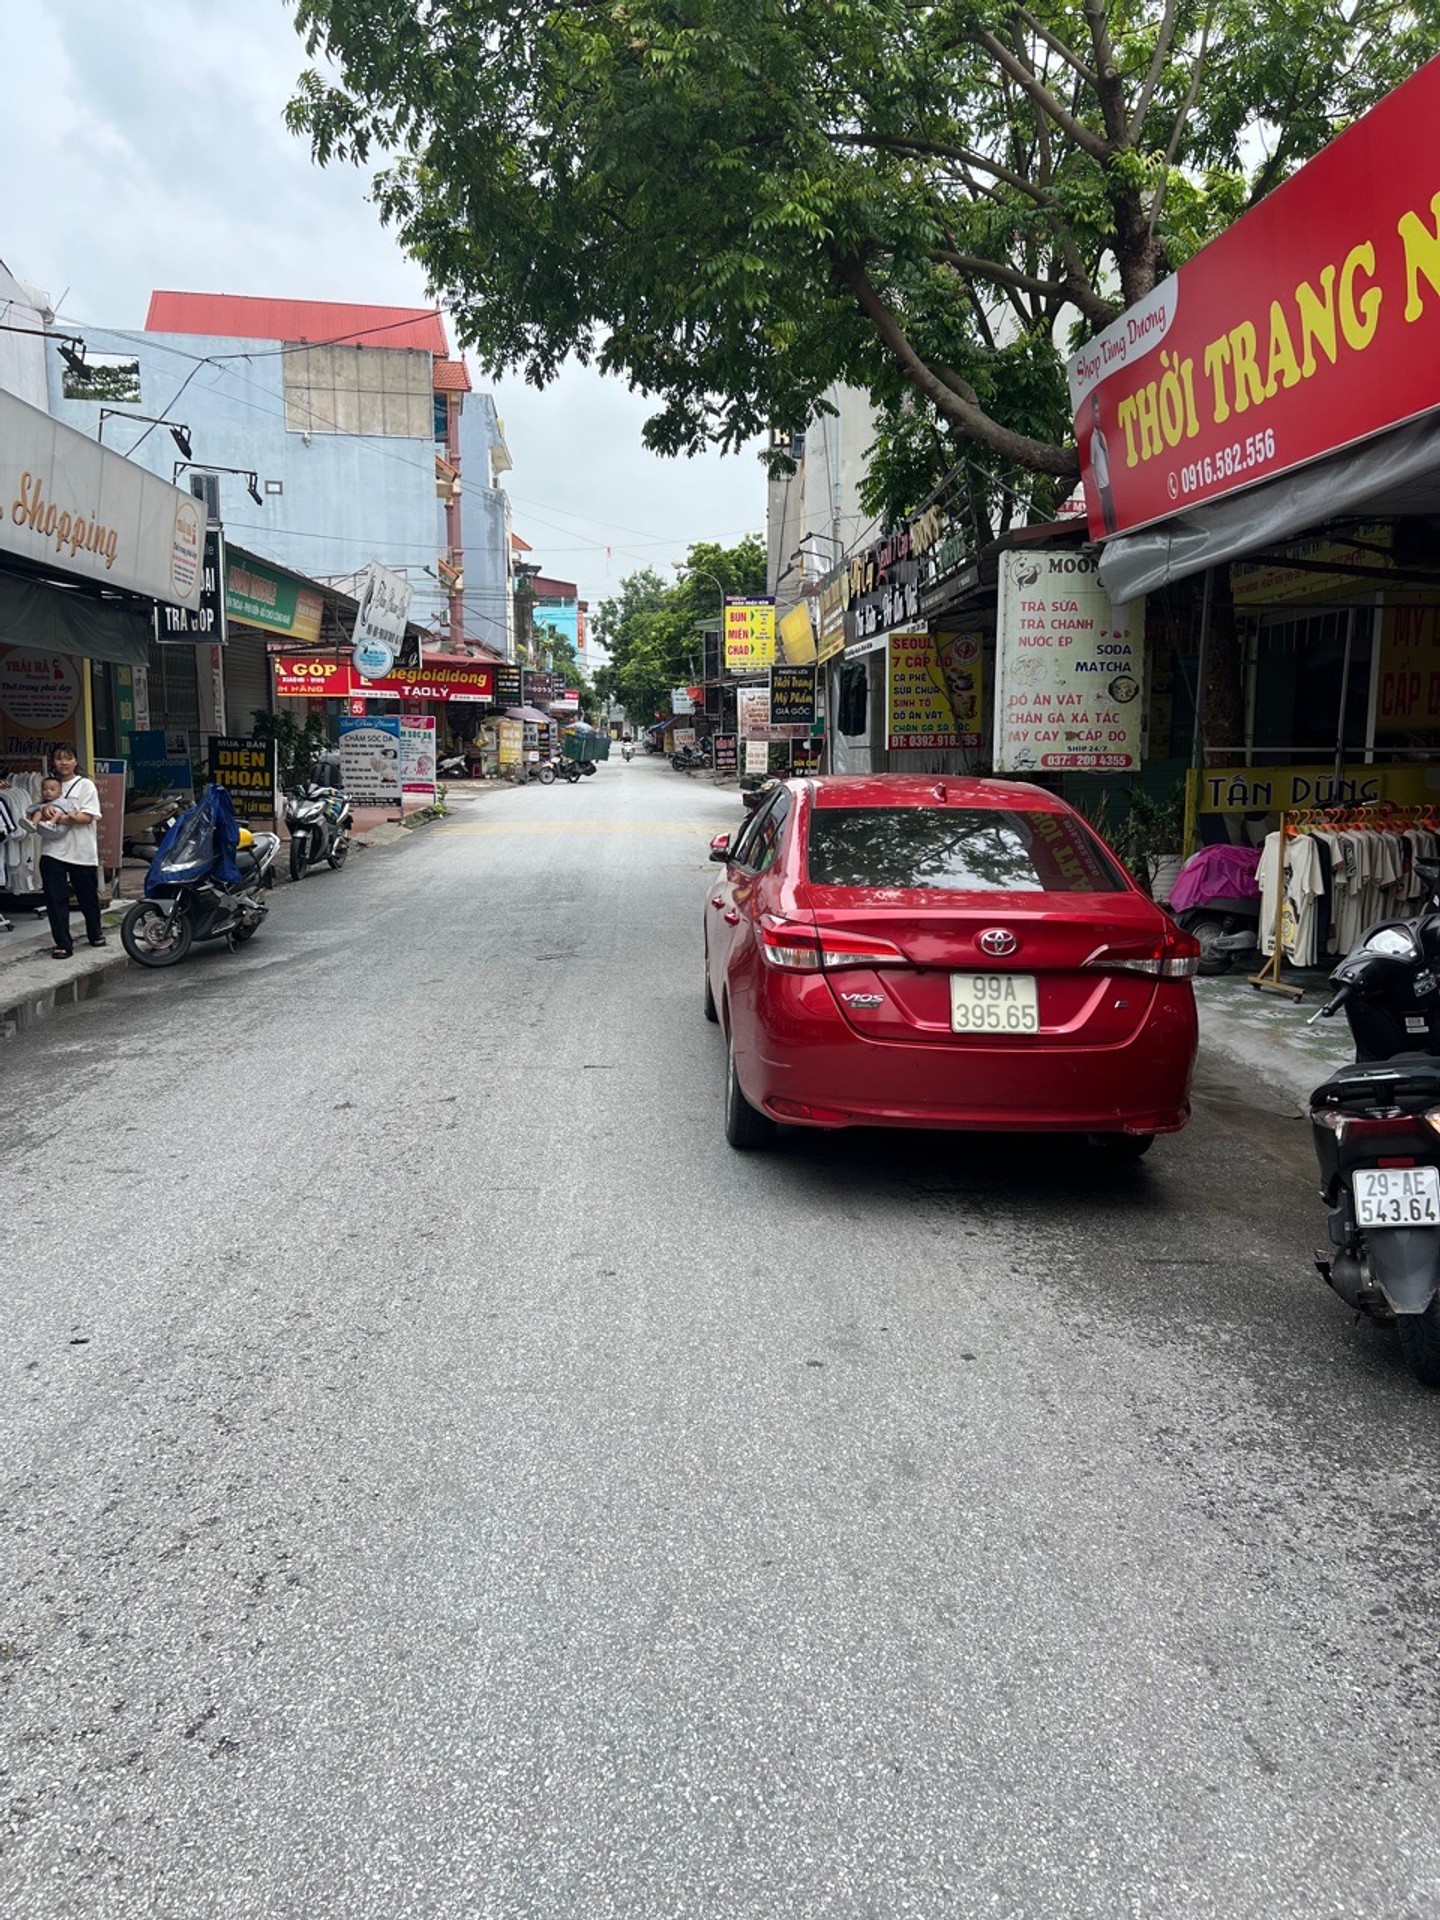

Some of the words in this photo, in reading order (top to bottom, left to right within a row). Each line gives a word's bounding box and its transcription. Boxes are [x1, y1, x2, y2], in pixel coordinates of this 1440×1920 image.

[1118, 349, 1200, 468] THỜI
[1204, 240, 1382, 424] TRANG
[1077, 356, 1100, 386] Shop
[1181, 428, 1276, 494] 0916.582.556
[12, 471, 118, 570] Shopping
[1021, 599, 1046, 611] TRÀ
[1051, 600, 1078, 611] SỮA
[1020, 617, 1045, 630] TRÀ
[1051, 619, 1093, 630] CHANH
[892, 638, 934, 650] SEOUL
[1018, 635, 1053, 647] NƯỚC
[1058, 635, 1073, 647] ÉP
[1097, 645, 1132, 655] SODA
[292, 658, 337, 677] GÓP
[892, 656, 901, 668] 7
[1075, 662, 1132, 672] MATCHA
[1009, 692, 1028, 705] ĐỒ
[1033, 692, 1051, 705] ĂN
[1009, 711, 1042, 723] CHÂN
[1048, 711, 1065, 723] GÀ
[1034, 730, 1060, 741] CAY
[1108, 729, 1126, 742] ĐỘ
[217, 739, 239, 748] MUA
[246, 738, 266, 749] BÁN
[135, 757, 187, 769] vinaphone
[218, 748, 266, 769] ĐIỆN
[1100, 754, 1126, 766] 4355
[213, 770, 271, 789] THOẠI
[1207, 774, 1271, 807] TẤN
[1292, 775, 1378, 804] DŨNG
[972, 976, 1017, 1001] 99A
[841, 993, 885, 1003] VIOS
[956, 1004, 1035, 1029] 395.65
[1366, 1172, 1426, 1196] 29-AE
[1361, 1198, 1436, 1222] 543.64
